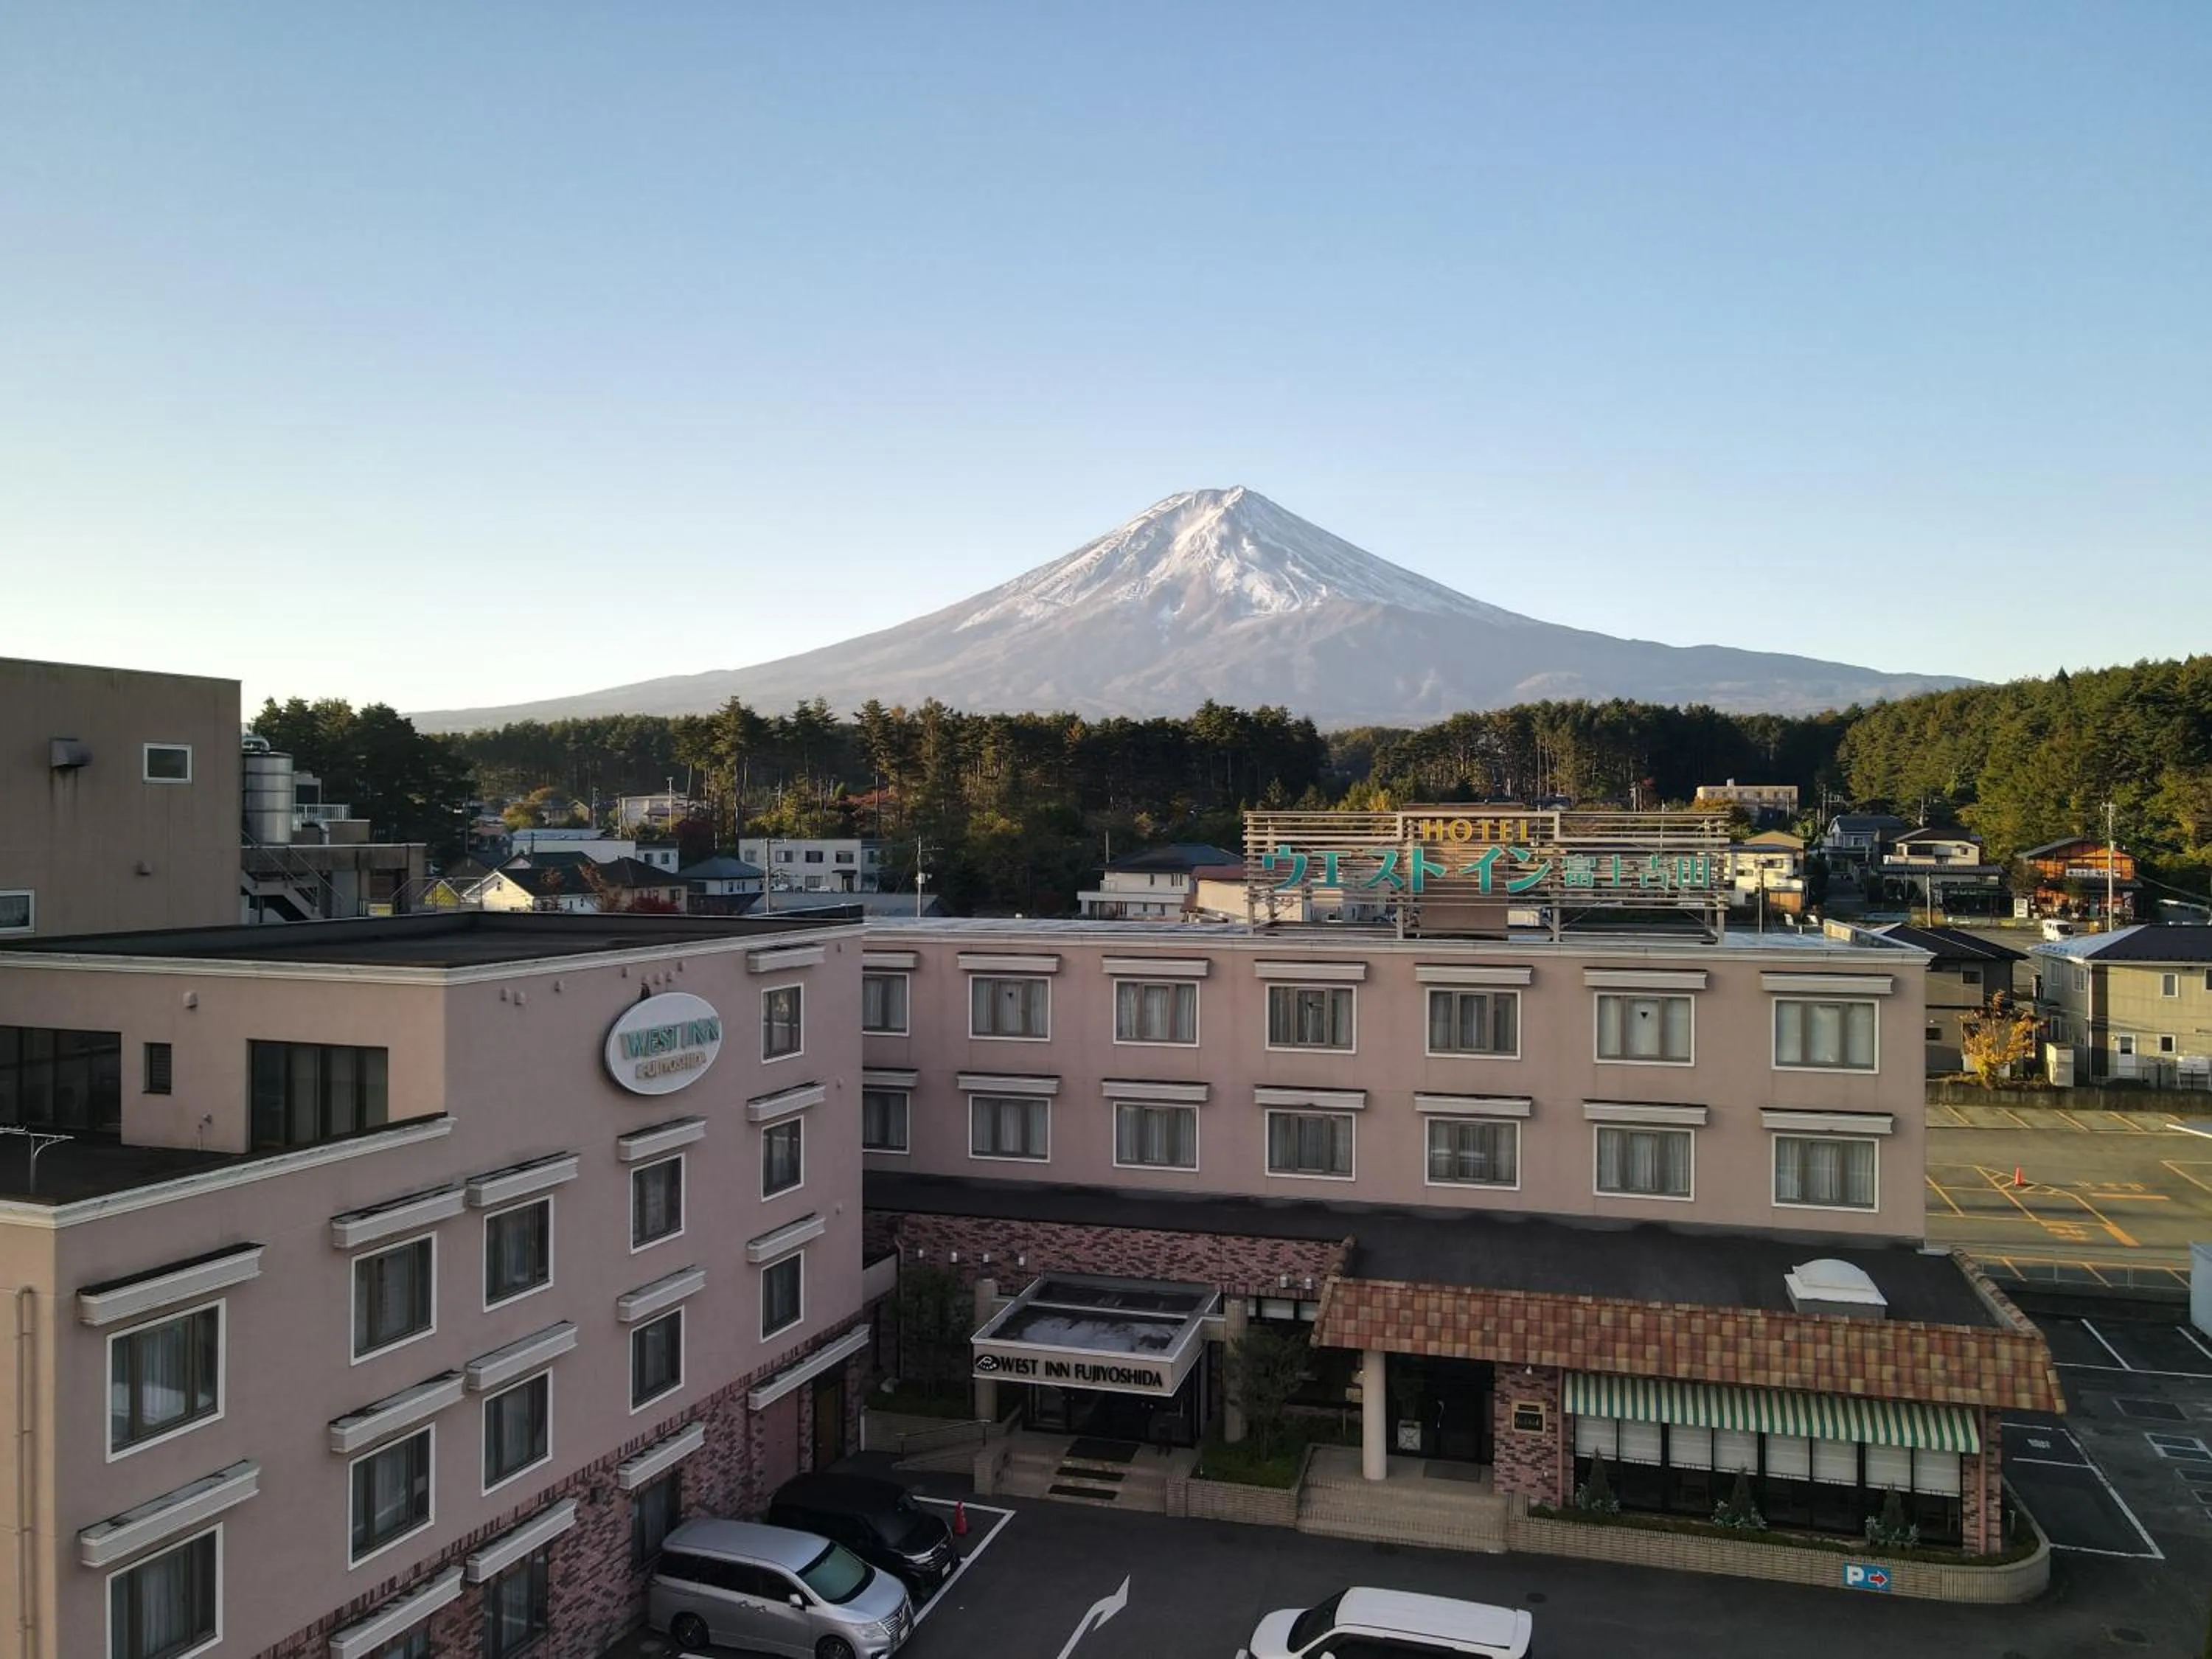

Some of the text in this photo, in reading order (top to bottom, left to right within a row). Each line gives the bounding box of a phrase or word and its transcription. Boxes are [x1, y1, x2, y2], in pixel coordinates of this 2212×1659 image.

[1421, 818, 1528, 842] HOTEL
[619, 1015, 720, 1060] WEST INN
[1000, 1356, 1163, 1387] WEST INN FUJIYOSHIDA
[1846, 1565, 1865, 1585] P
